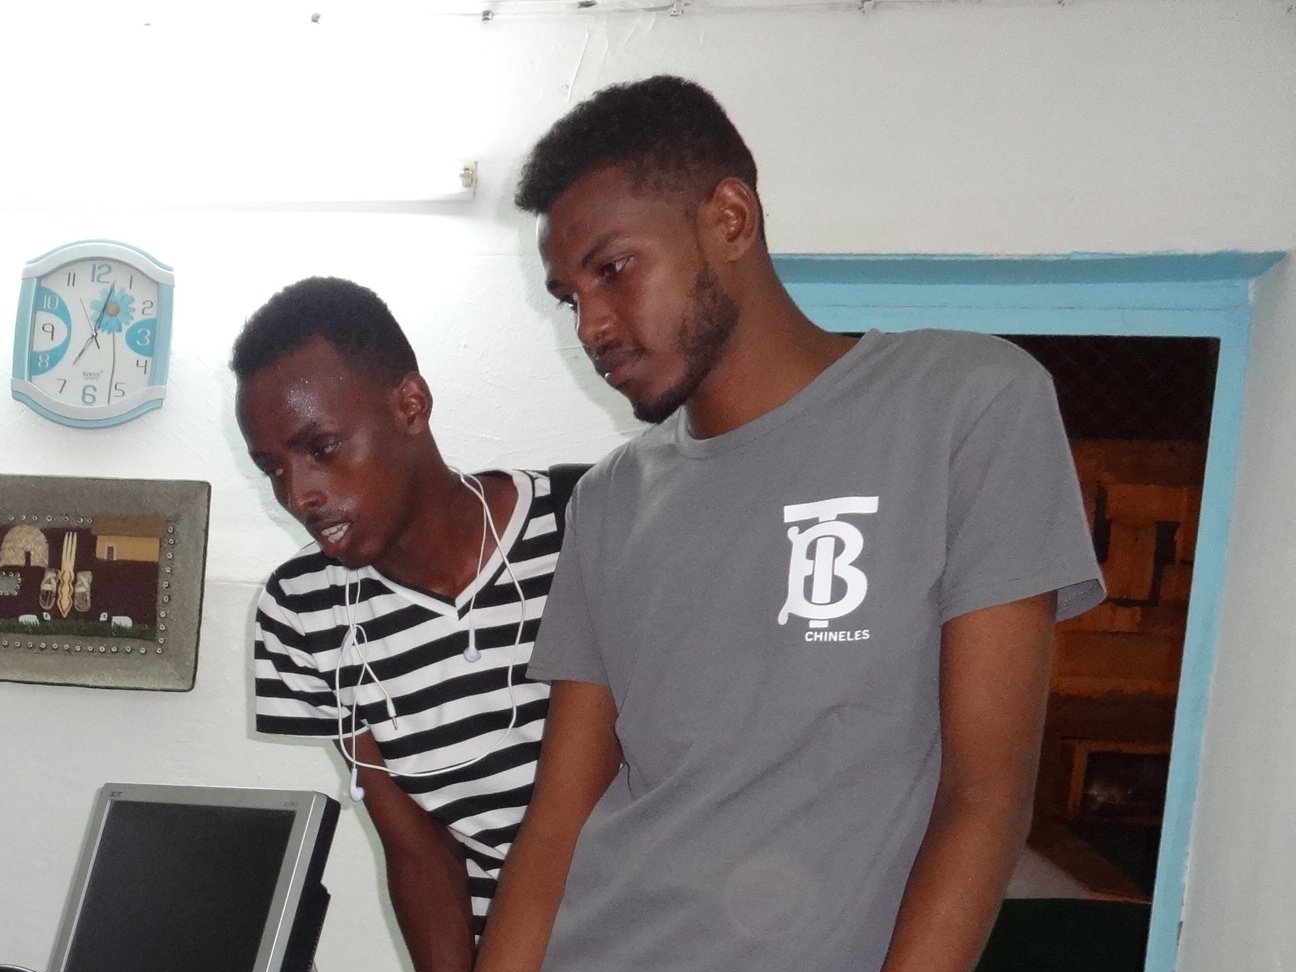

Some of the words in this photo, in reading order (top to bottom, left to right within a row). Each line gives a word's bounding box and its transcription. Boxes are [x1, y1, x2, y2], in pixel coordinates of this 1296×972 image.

[67, 272, 76, 287] 11
[90, 263, 112, 284] 12
[128, 275, 134, 290] 1
[43, 294, 59, 310] 10
[141, 300, 154, 316] 2
[41, 323, 55, 341] 9
[136, 328, 151, 347] 3
[38, 354, 50, 368] 8
[136, 359, 148, 375] 4
[56, 378, 68, 394] 7
[114, 382, 126, 398] 5
[81, 384, 98, 405] 6
[805, 629, 871, 642] CHINELES
